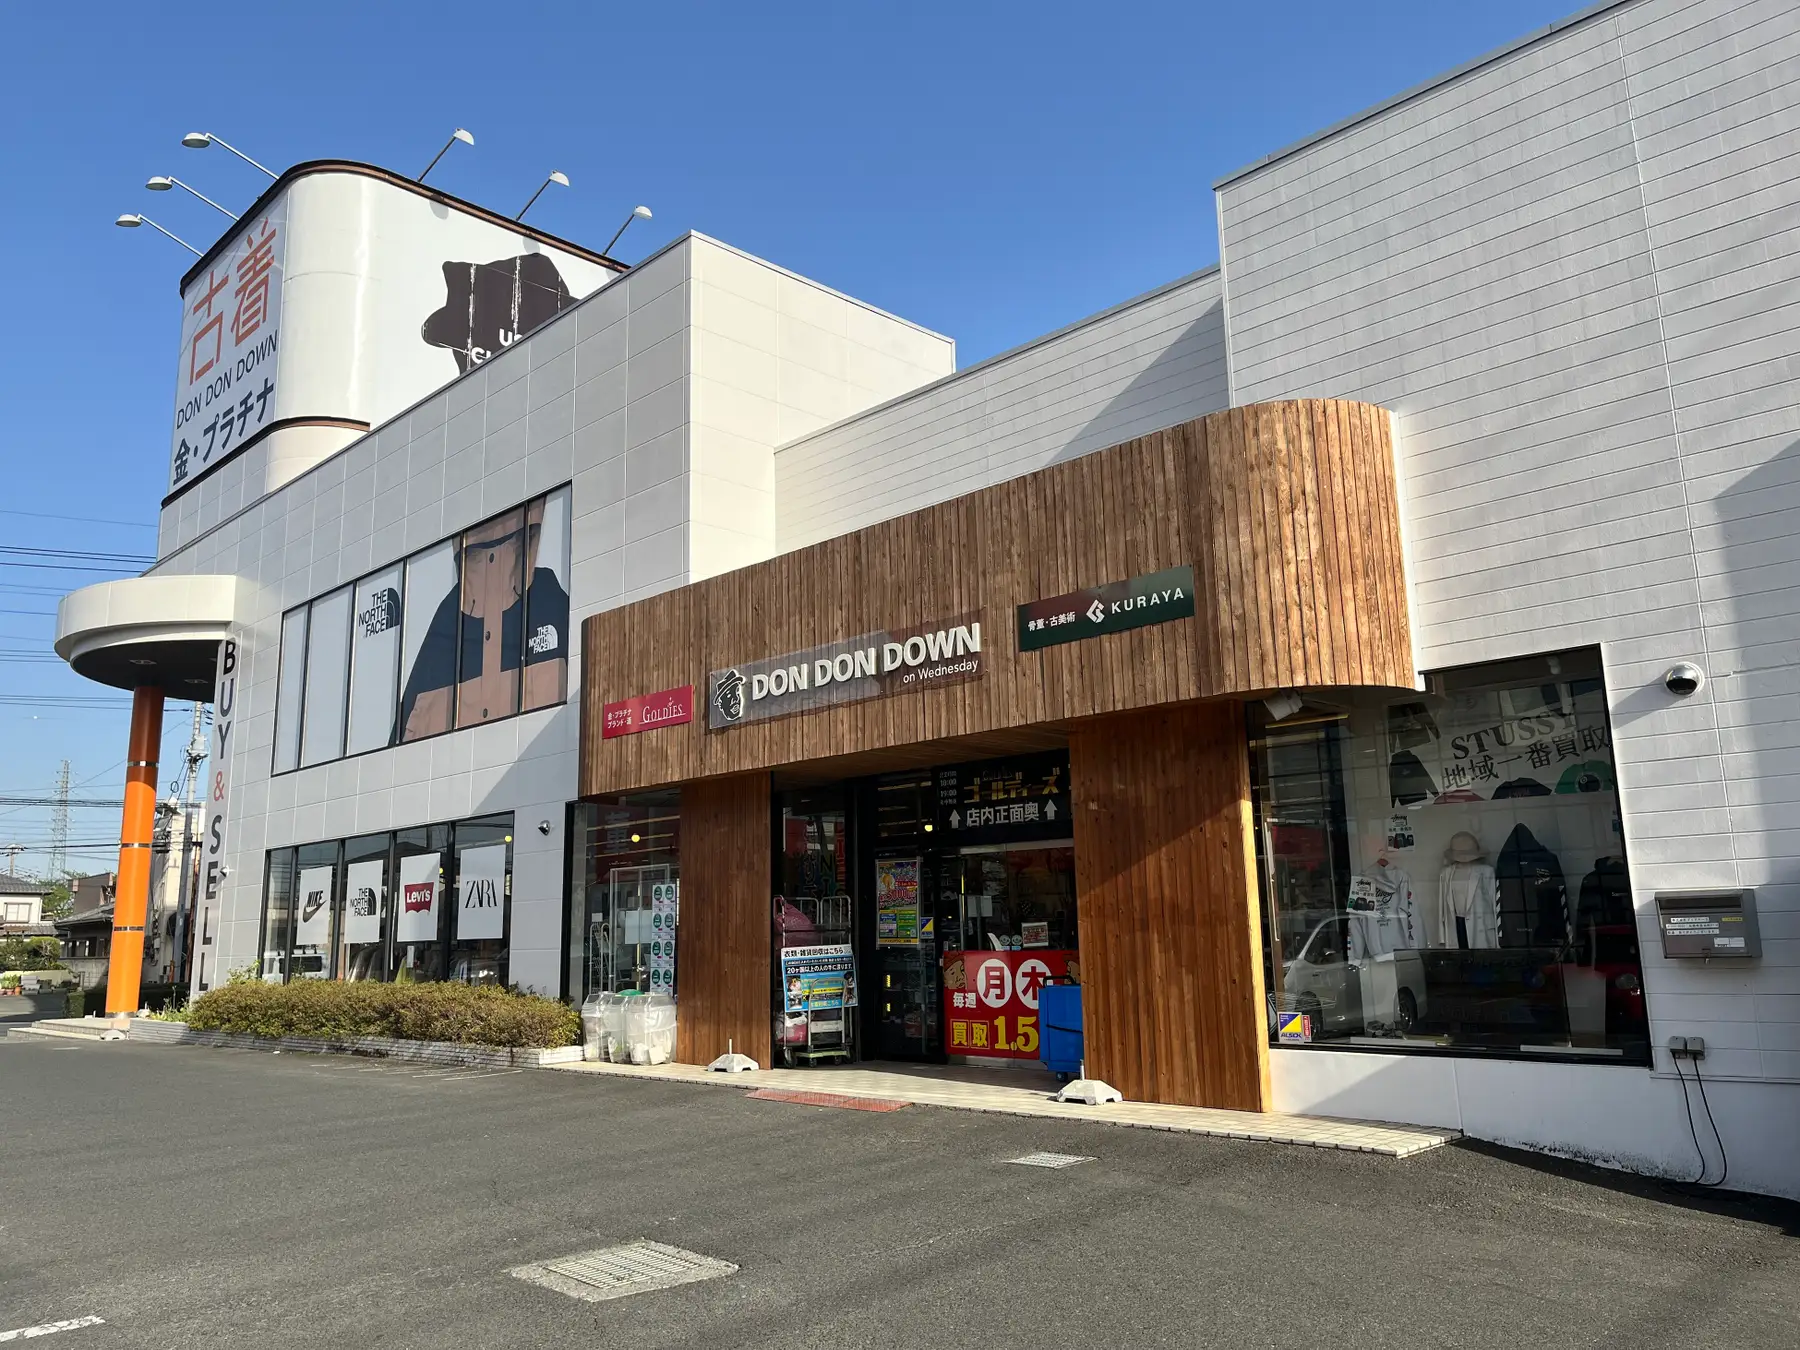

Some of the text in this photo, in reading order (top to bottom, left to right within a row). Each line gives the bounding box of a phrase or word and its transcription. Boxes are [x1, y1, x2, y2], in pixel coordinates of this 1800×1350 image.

[190, 216, 277, 386] 古着
[177, 329, 278, 430] DON DON DOWN
[173, 376, 275, 486] 金・プラチナ
[371, 588, 387, 607] THE
[1111, 587, 1184, 614] KURAYA
[358, 601, 387, 627] NORTH
[365, 616, 387, 637] FACE
[1027, 611, 1076, 632] 骨董・古美術
[528, 633, 549, 648] NORTH
[536, 625, 549, 636] THE
[533, 642, 549, 654] FACE
[751, 622, 981, 701] DON DON DOWN
[903, 658, 979, 684] on Wednesday
[1451, 707, 1577, 760] STUSSY
[1443, 724, 1609, 790] 地域一番買取
[198, 640, 236, 992] BUY & SELL
[966, 802, 1040, 828] 店内正面奥
[305, 890, 324, 908] NIKE
[350, 898, 369, 907] NORTH
[358, 887, 369, 897] THE
[464, 878, 498, 909] ZARA
[354, 907, 368, 916] FACE
[953, 966, 1047, 1008] 毎週 月 木
[953, 1015, 1039, 1053] 買取 1.5
